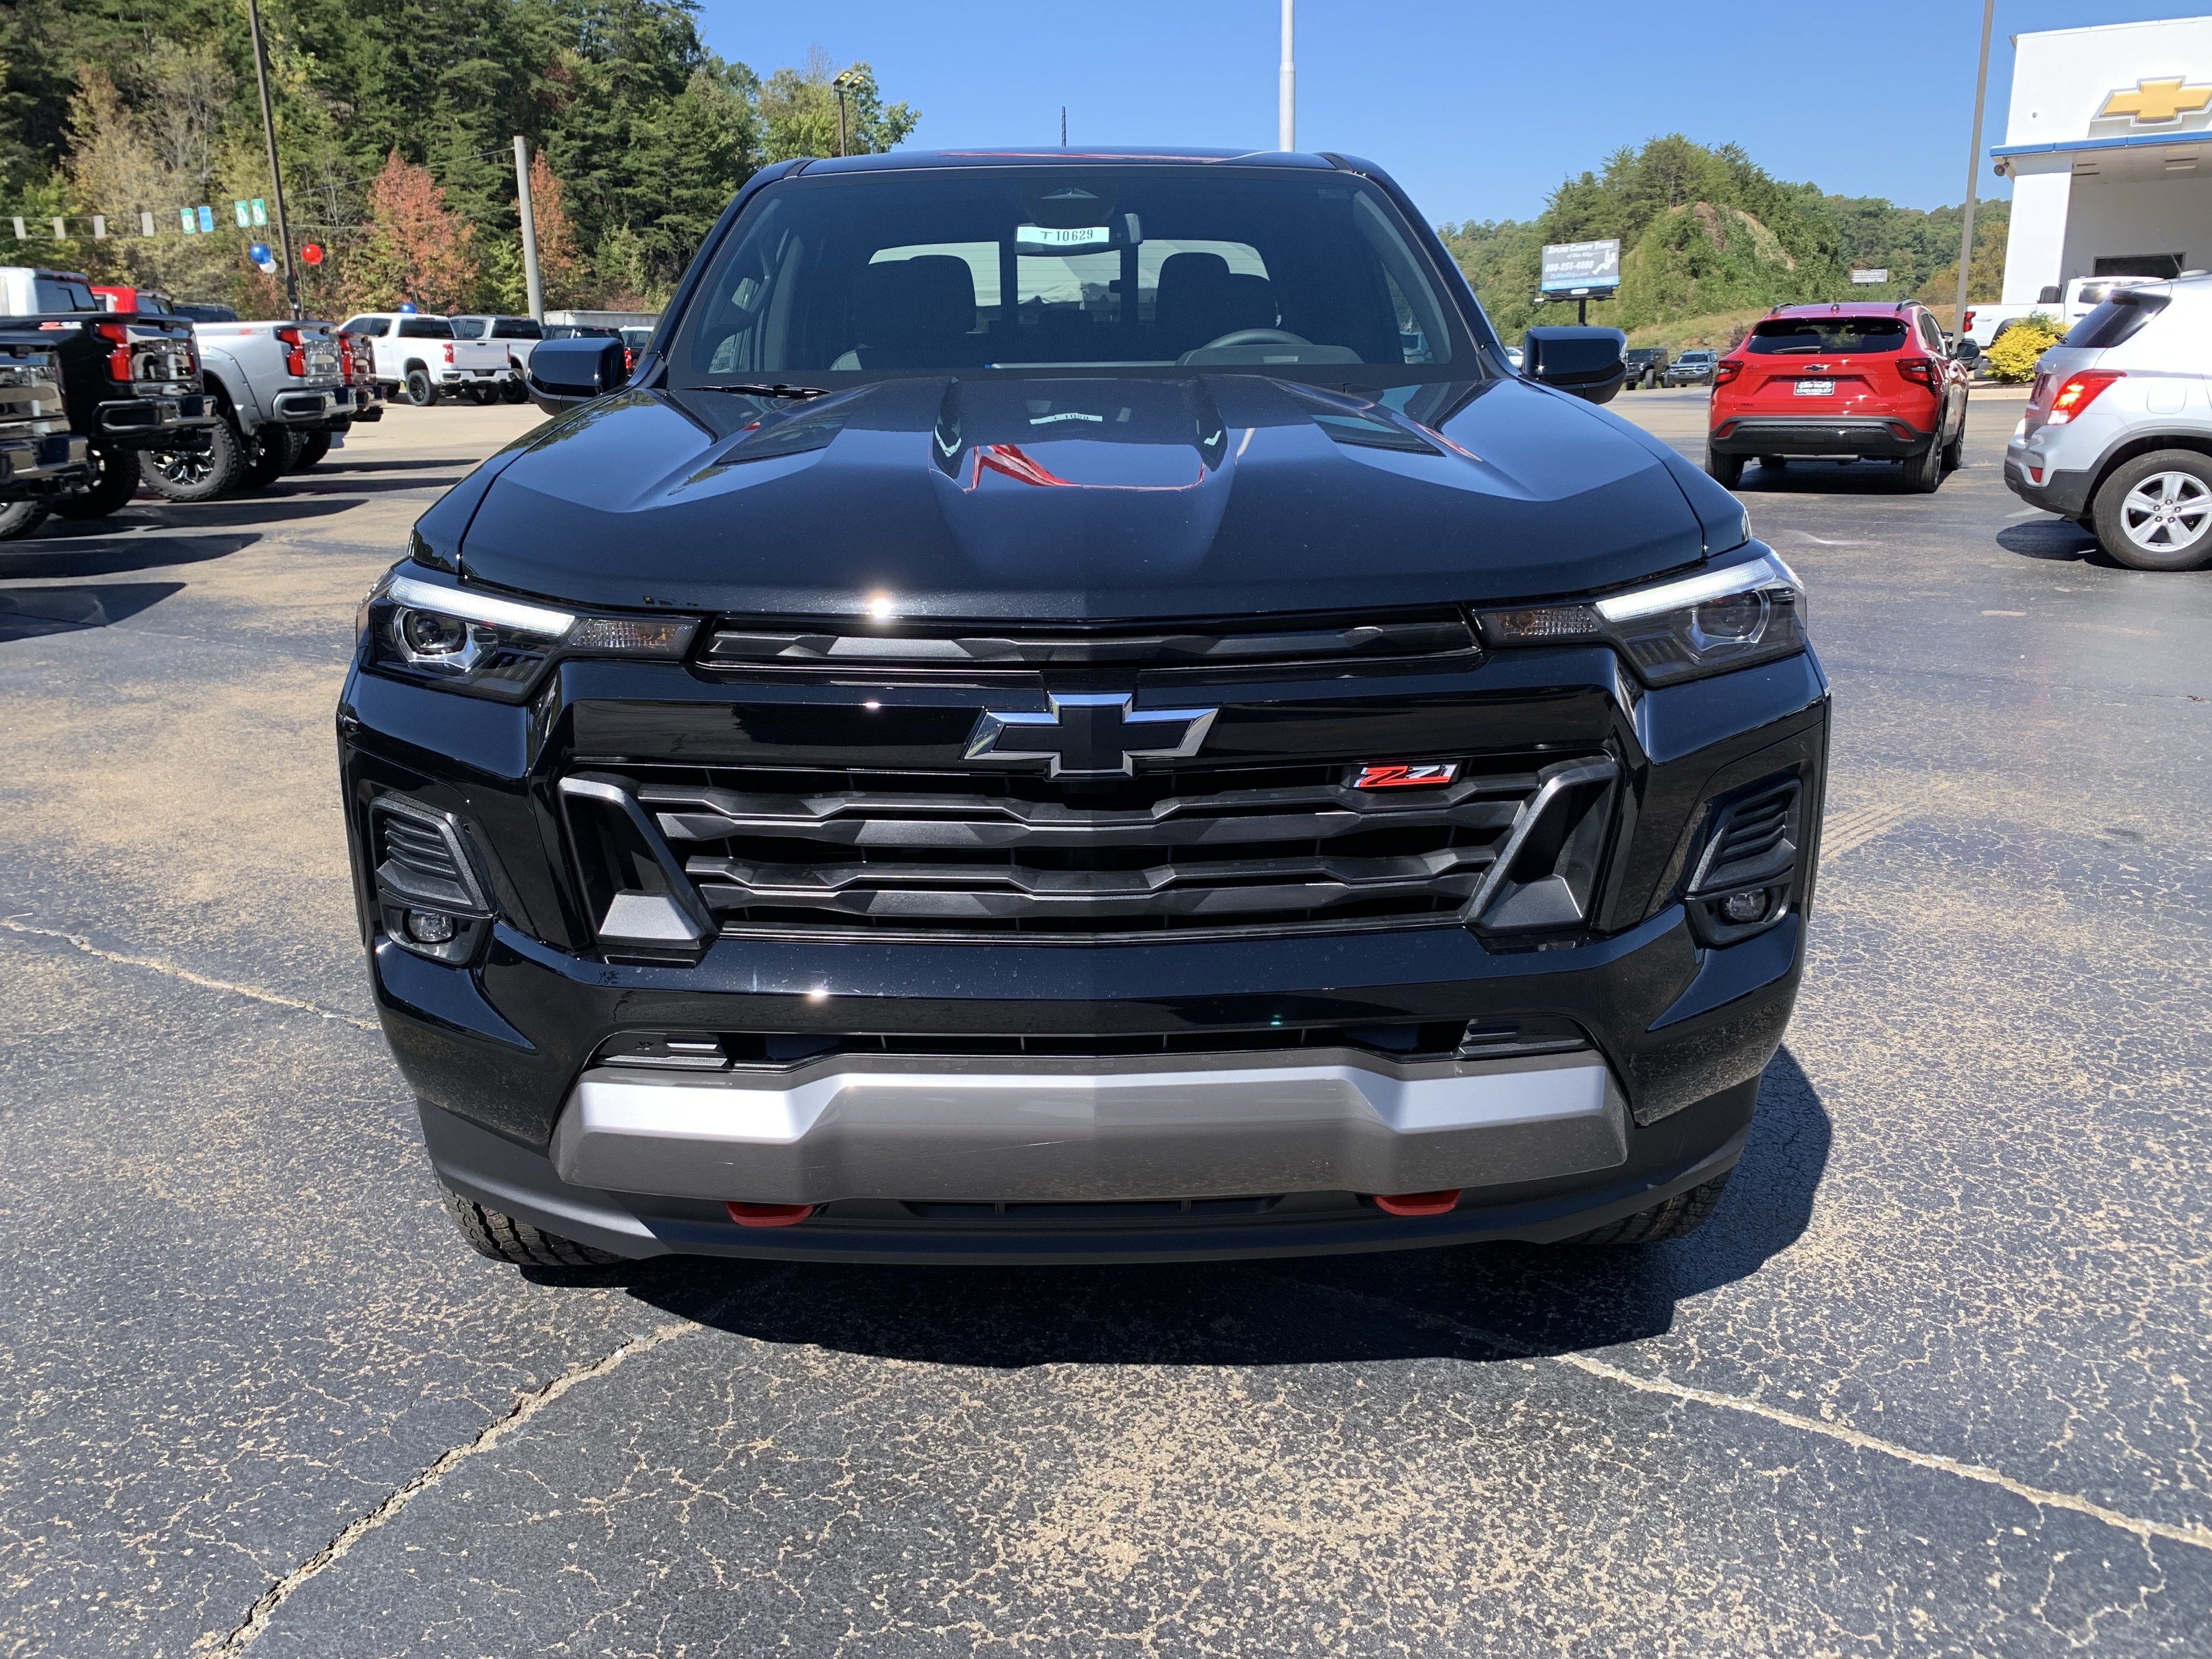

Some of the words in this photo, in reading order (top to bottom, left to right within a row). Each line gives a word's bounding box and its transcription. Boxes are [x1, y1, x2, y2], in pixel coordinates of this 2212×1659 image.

[1040, 231, 1053, 240] T
[1056, 229, 1093, 241] 10629
[1353, 764, 1458, 788] Z71
